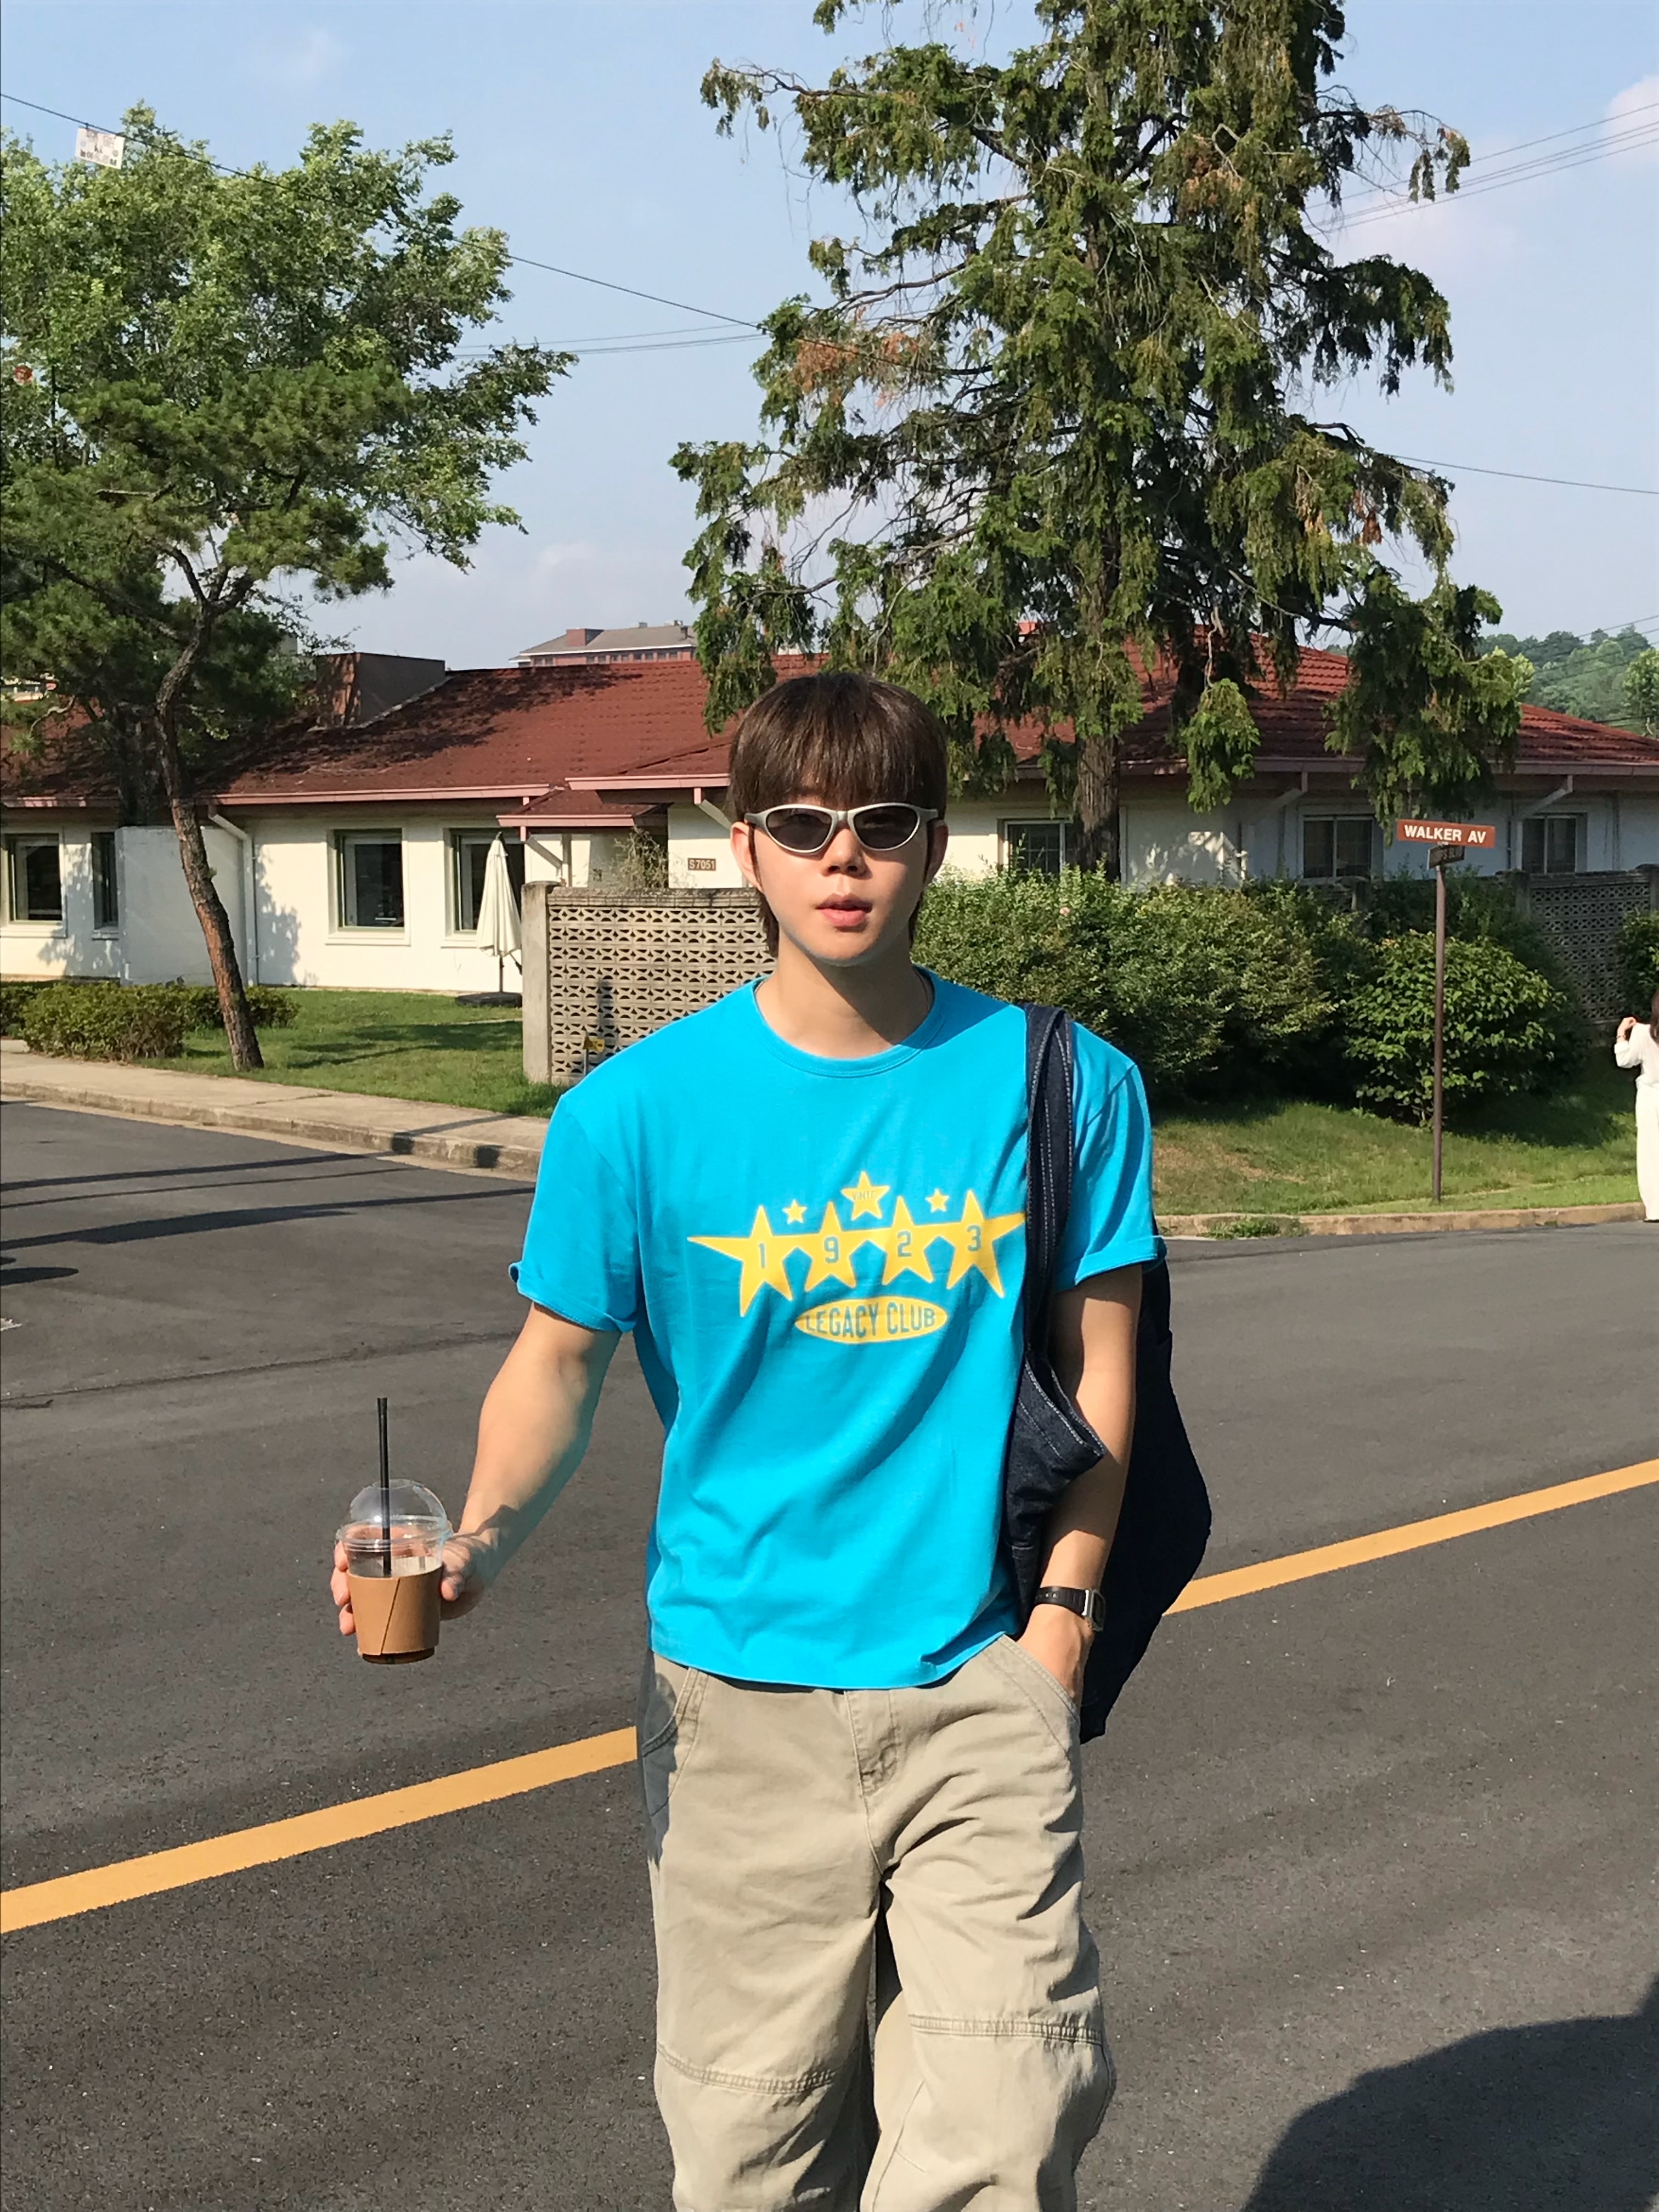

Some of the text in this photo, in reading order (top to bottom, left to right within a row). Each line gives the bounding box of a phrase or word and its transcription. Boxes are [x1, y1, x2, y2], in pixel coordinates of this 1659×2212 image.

[1404, 824, 1487, 844] WALKER AV
[689, 859, 715, 870] S7051
[806, 1301, 936, 1338] LEGACY CLUB
